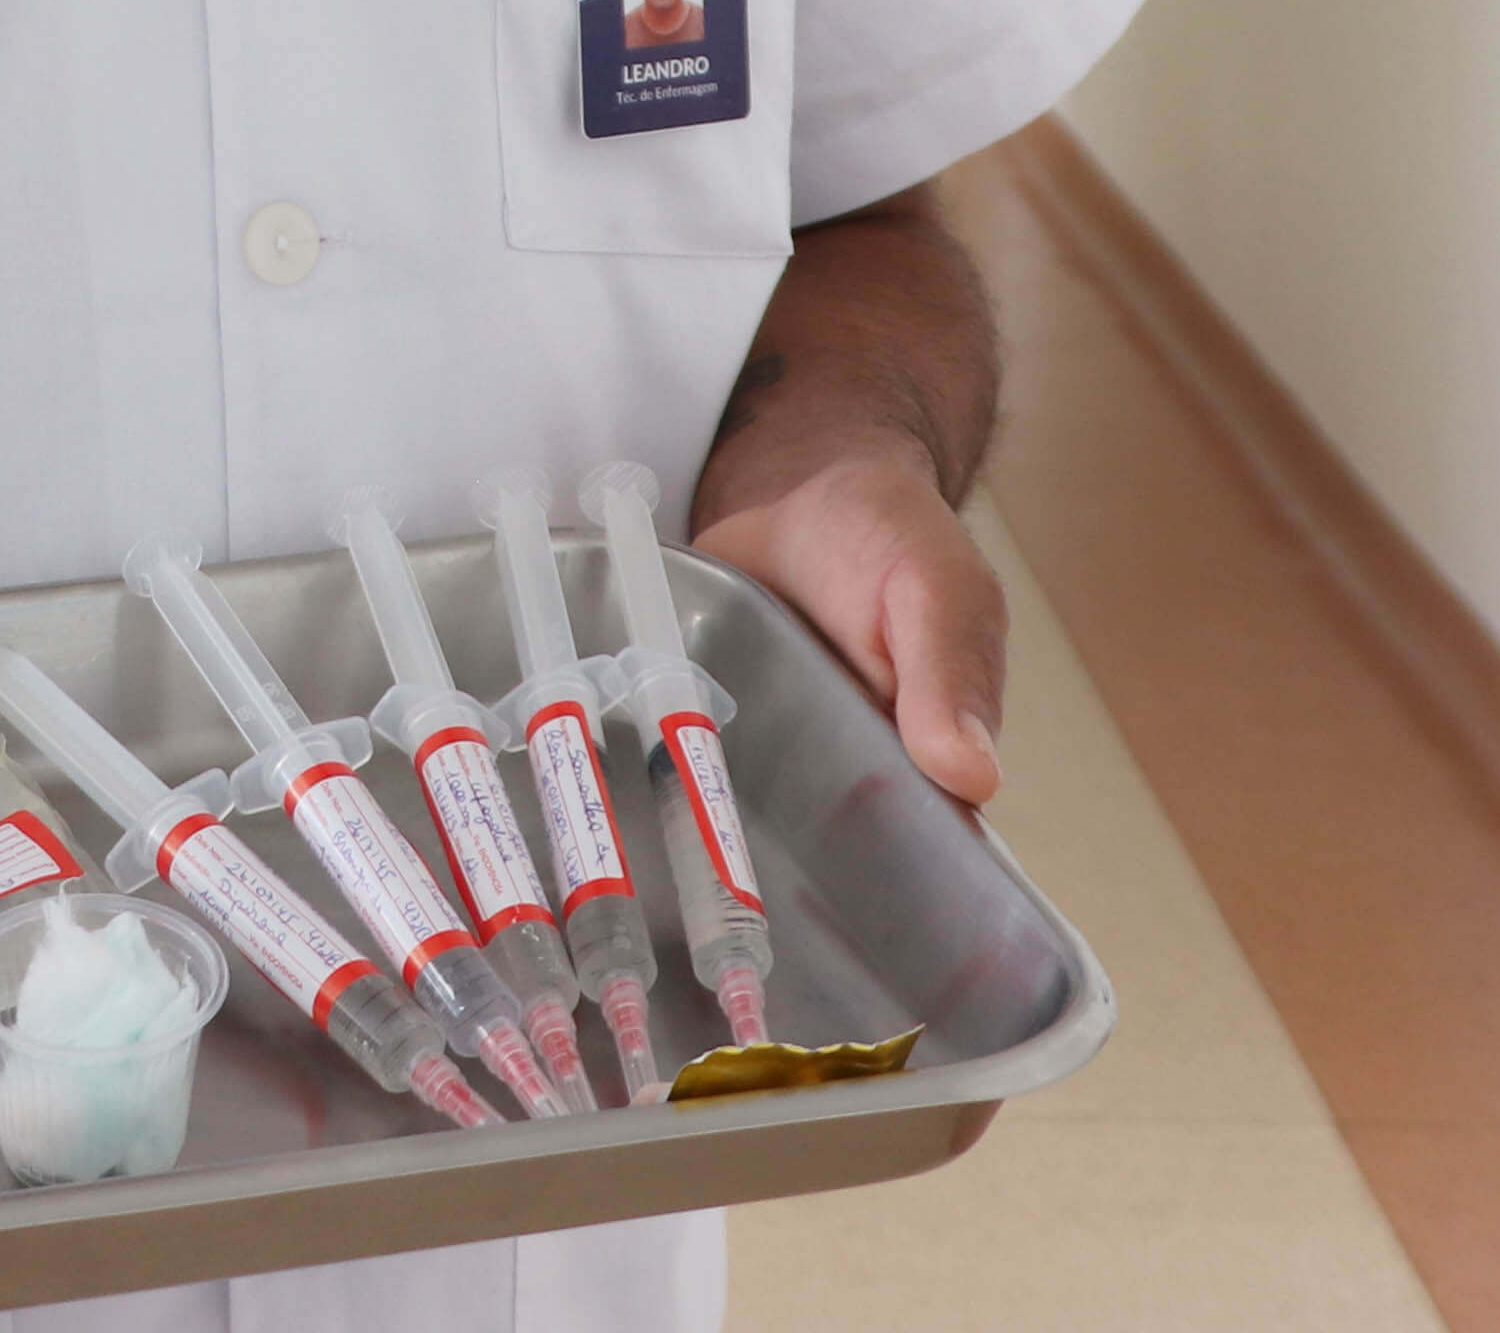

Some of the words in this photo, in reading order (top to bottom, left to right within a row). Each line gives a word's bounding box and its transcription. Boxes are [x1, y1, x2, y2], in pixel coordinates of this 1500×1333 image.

[622, 55, 710, 84] LEANDRO
[640, 89, 654, 102] de
[655, 81, 719, 101] Enfermagem
